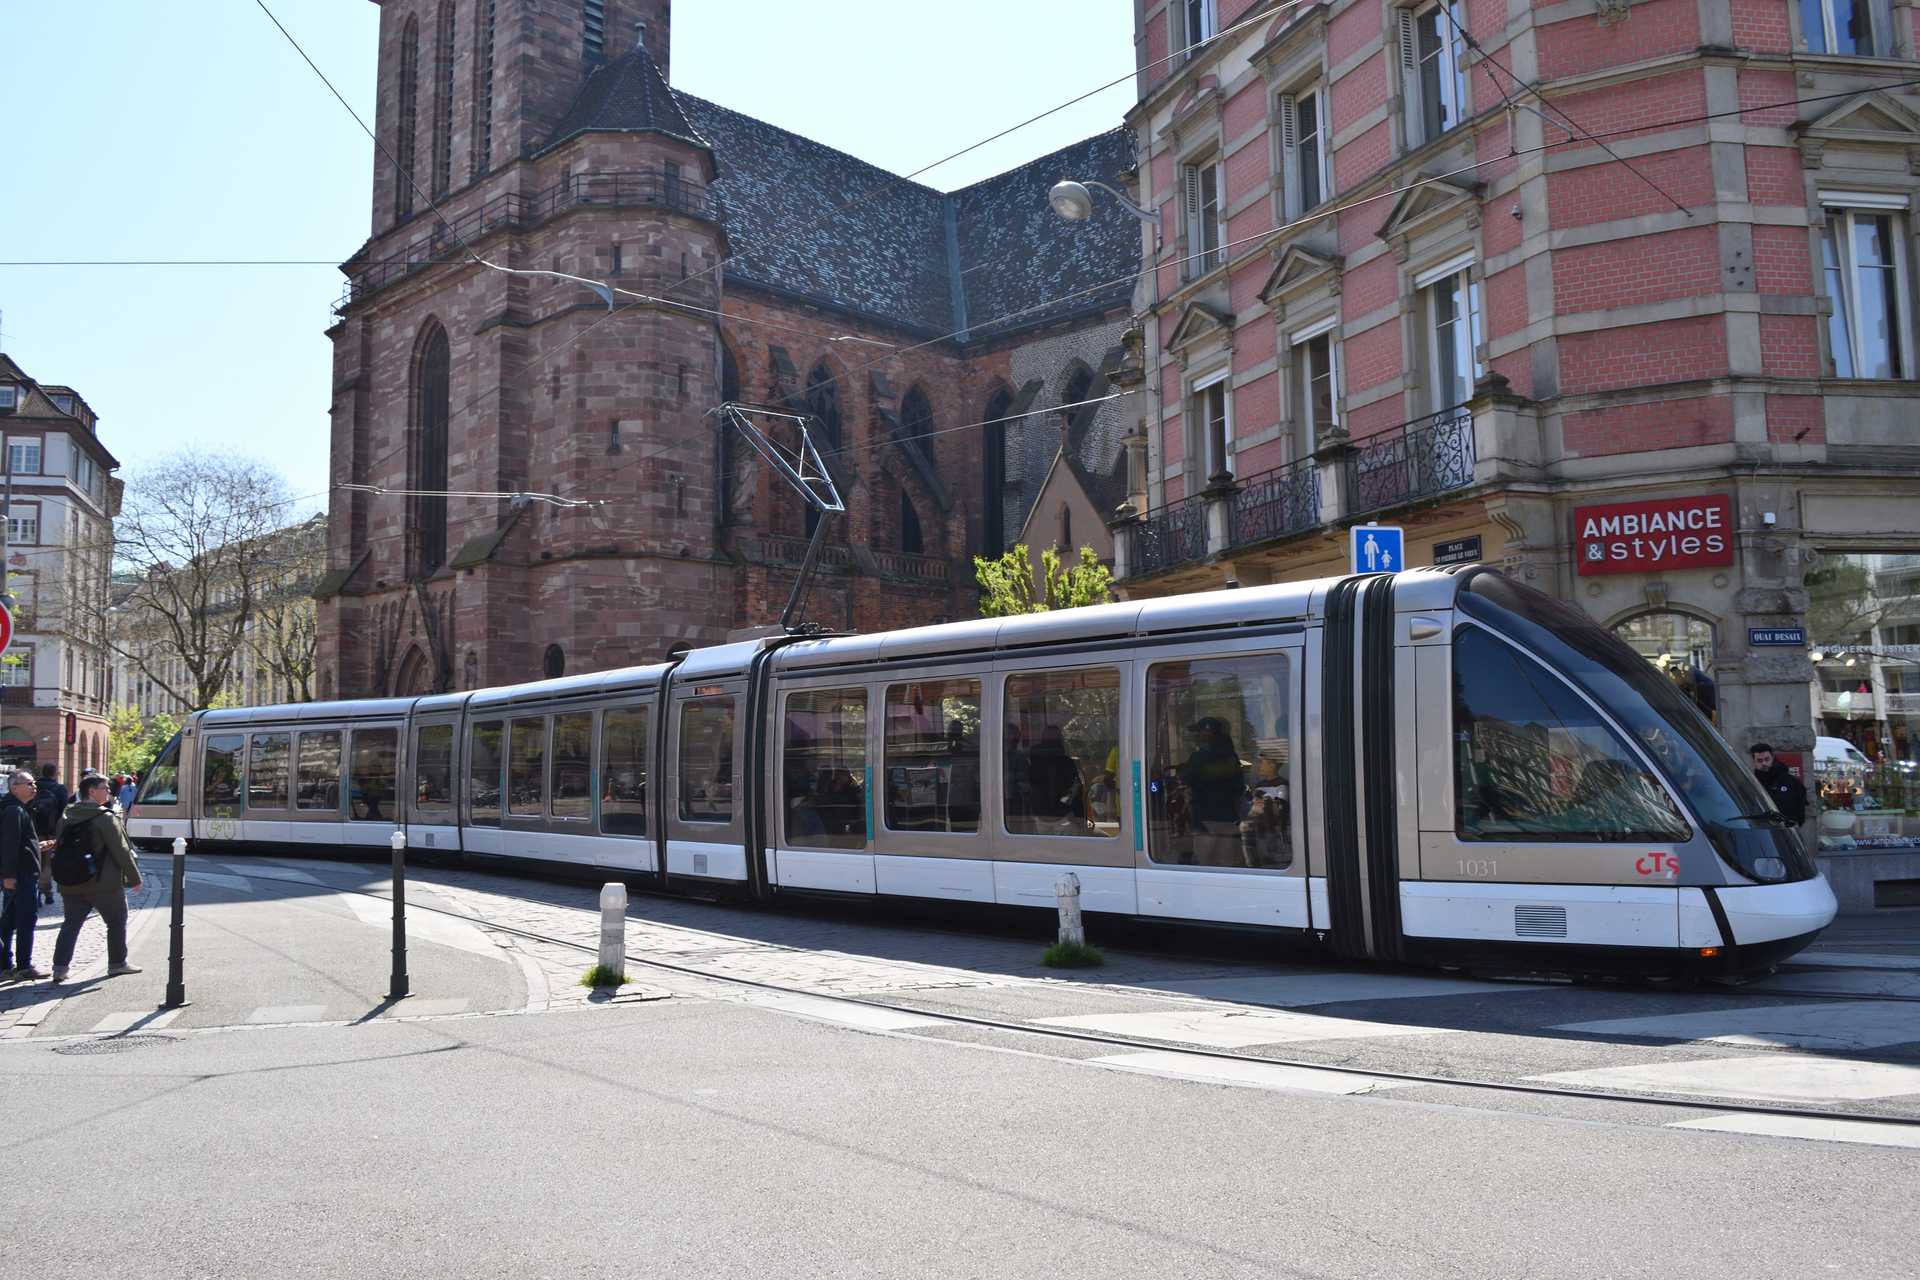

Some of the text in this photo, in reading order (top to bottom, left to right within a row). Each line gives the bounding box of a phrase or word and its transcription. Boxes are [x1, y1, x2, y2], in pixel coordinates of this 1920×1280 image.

[1583, 507, 1722, 538] AMBIANCE
[1588, 534, 1724, 561] & styles
[1753, 632, 1801, 642] QUAI DESAIX
[1456, 859, 1497, 877] 1031
